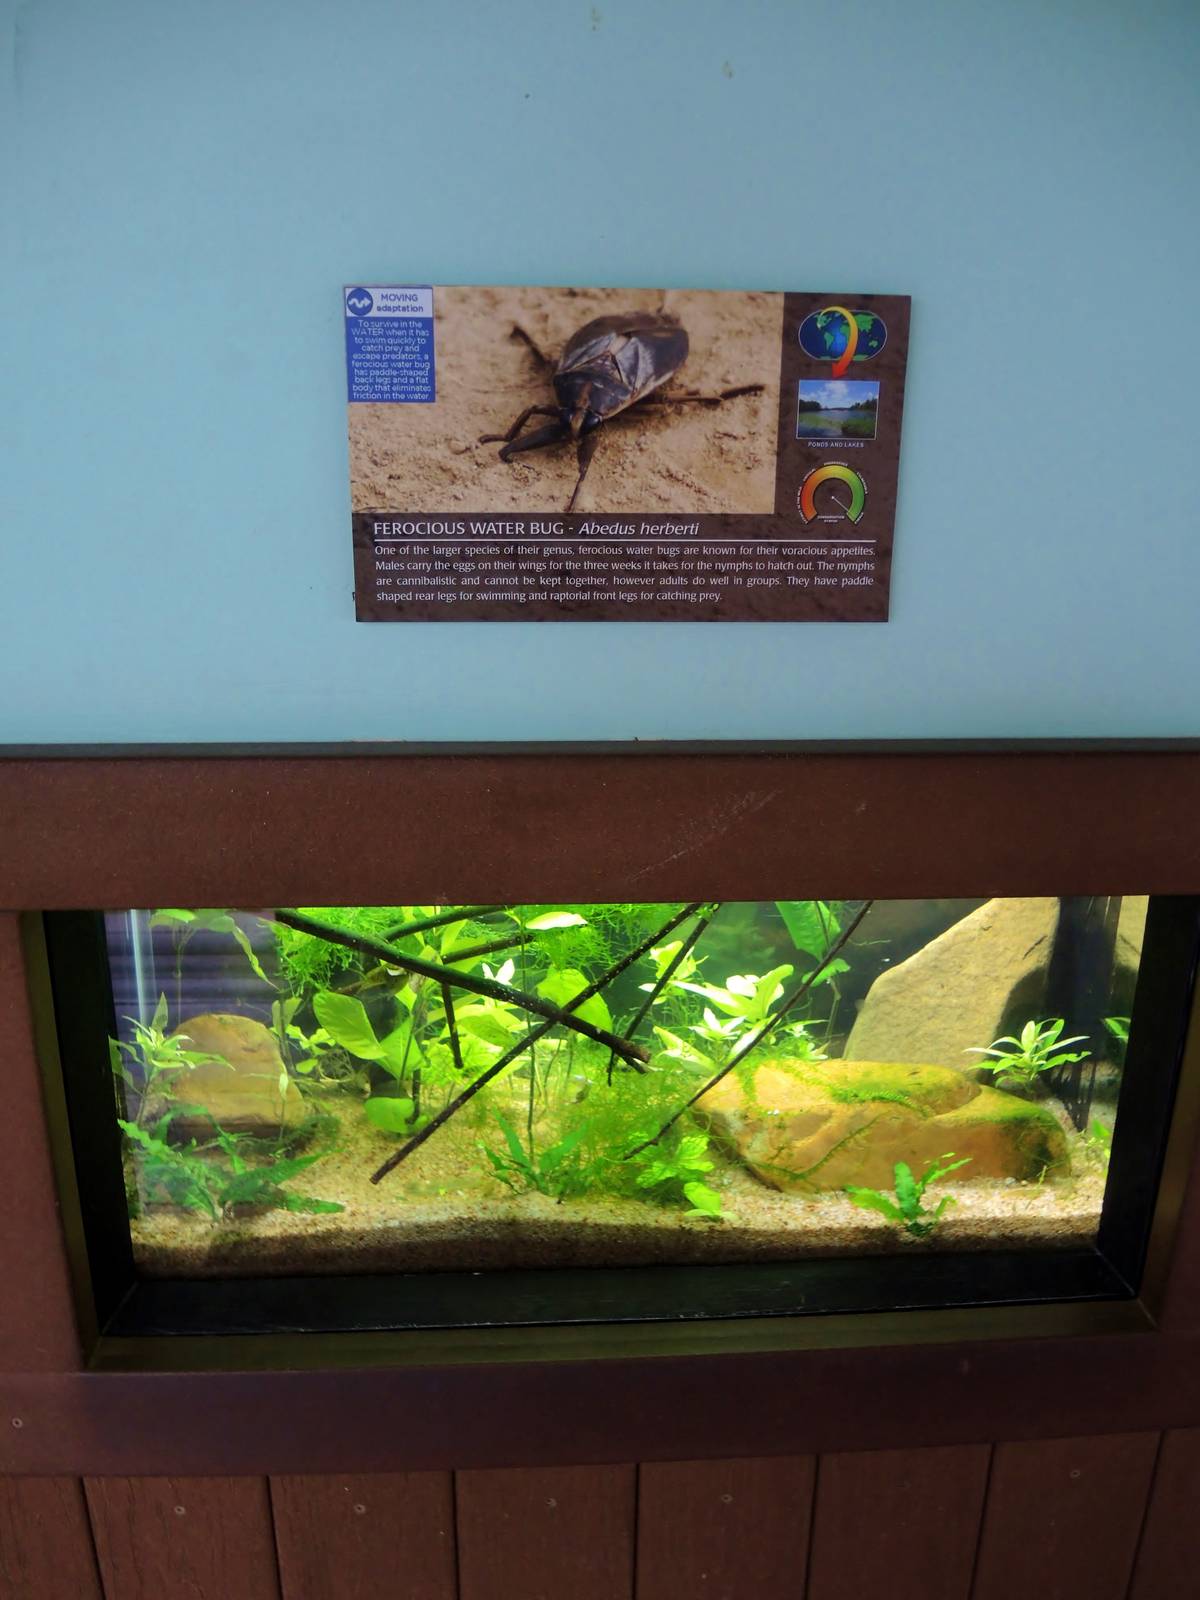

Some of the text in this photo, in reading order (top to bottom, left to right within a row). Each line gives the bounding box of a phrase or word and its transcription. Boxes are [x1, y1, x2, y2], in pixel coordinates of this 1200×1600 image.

[381, 293, 418, 302] MOVING
[377, 305, 423, 313] adaptation
[358, 320, 422, 328] To survive in the
[388, 337, 415, 346] quickly
[385, 346, 402, 354] prey
[415, 361, 430, 370] bug
[370, 368, 428, 377] paddle-shaped
[376, 376, 391, 385] legs
[353, 384, 373, 393] body
[374, 522, 465, 534] FEROCIOUS
[470, 522, 525, 534] WATER
[530, 522, 564, 534] BUG
[579, 522, 636, 534] Abedus
[640, 522, 699, 534] herberti
[375, 546, 396, 555] One
[400, 546, 410, 555] of
[413, 546, 429, 555] the
[433, 546, 460, 557] larger
[465, 546, 500, 557] species
[504, 546, 514, 555] of
[517, 546, 539, 555] their
[543, 546, 575, 557] genus,
[579, 546, 623, 555] ferocious
[626, 547, 653, 555] water
[657, 546, 680, 557] bugs
[703, 546, 736, 555] known
[740, 546, 753, 555] for
[756, 546, 777, 555] their
[782, 546, 828, 556] voracious
[831, 546, 875, 557] appetites.
[375, 561, 404, 570] Males
[407, 563, 432, 572] carry
[434, 561, 450, 570] the
[453, 563, 475, 572] eggs
[494, 561, 515, 570] their
[518, 561, 547, 572] wings
[550, 561, 563, 570] for
[565, 561, 581, 570] the
[584, 561, 608, 570] three
[611, 561, 641, 570] weeks
[644, 561, 650, 570] it
[653, 561, 678, 570] takes
[681, 561, 694, 570] for
[697, 561, 712, 570] the
[715, 561, 753, 572] nymphs
[755, 562, 765, 571] to
[768, 561, 794, 571] hatch
[796, 562, 814, 571] out.
[817, 561, 835, 571] The
[837, 561, 875, 572] nymphs
[397, 577, 456, 585] cannibalistic
[461, 577, 480, 585] and
[485, 577, 518, 585] cannot
[523, 576, 535, 585] be
[540, 576, 561, 587] kept
[566, 576, 609, 587] together,
[613, 576, 655, 585] however
[659, 576, 688, 585] adults
[692, 576, 705, 585] do
[710, 577, 729, 585] well
[733, 577, 742, 585] in
[747, 578, 782, 587] groups.
[787, 577, 810, 587] They
[814, 577, 838, 586] have
[842, 577, 874, 587] paddle
[377, 592, 412, 603] shaped
[437, 592, 457, 603] legs
[460, 592, 473, 600] for
[476, 592, 526, 603] swimming
[529, 592, 547, 600] and
[550, 591, 590, 602] raptorial
[593, 591, 616, 600] front
[619, 592, 637, 603] legs
[640, 591, 654, 600] for
[657, 592, 697, 603] catching
[700, 593, 722, 603] prey.
